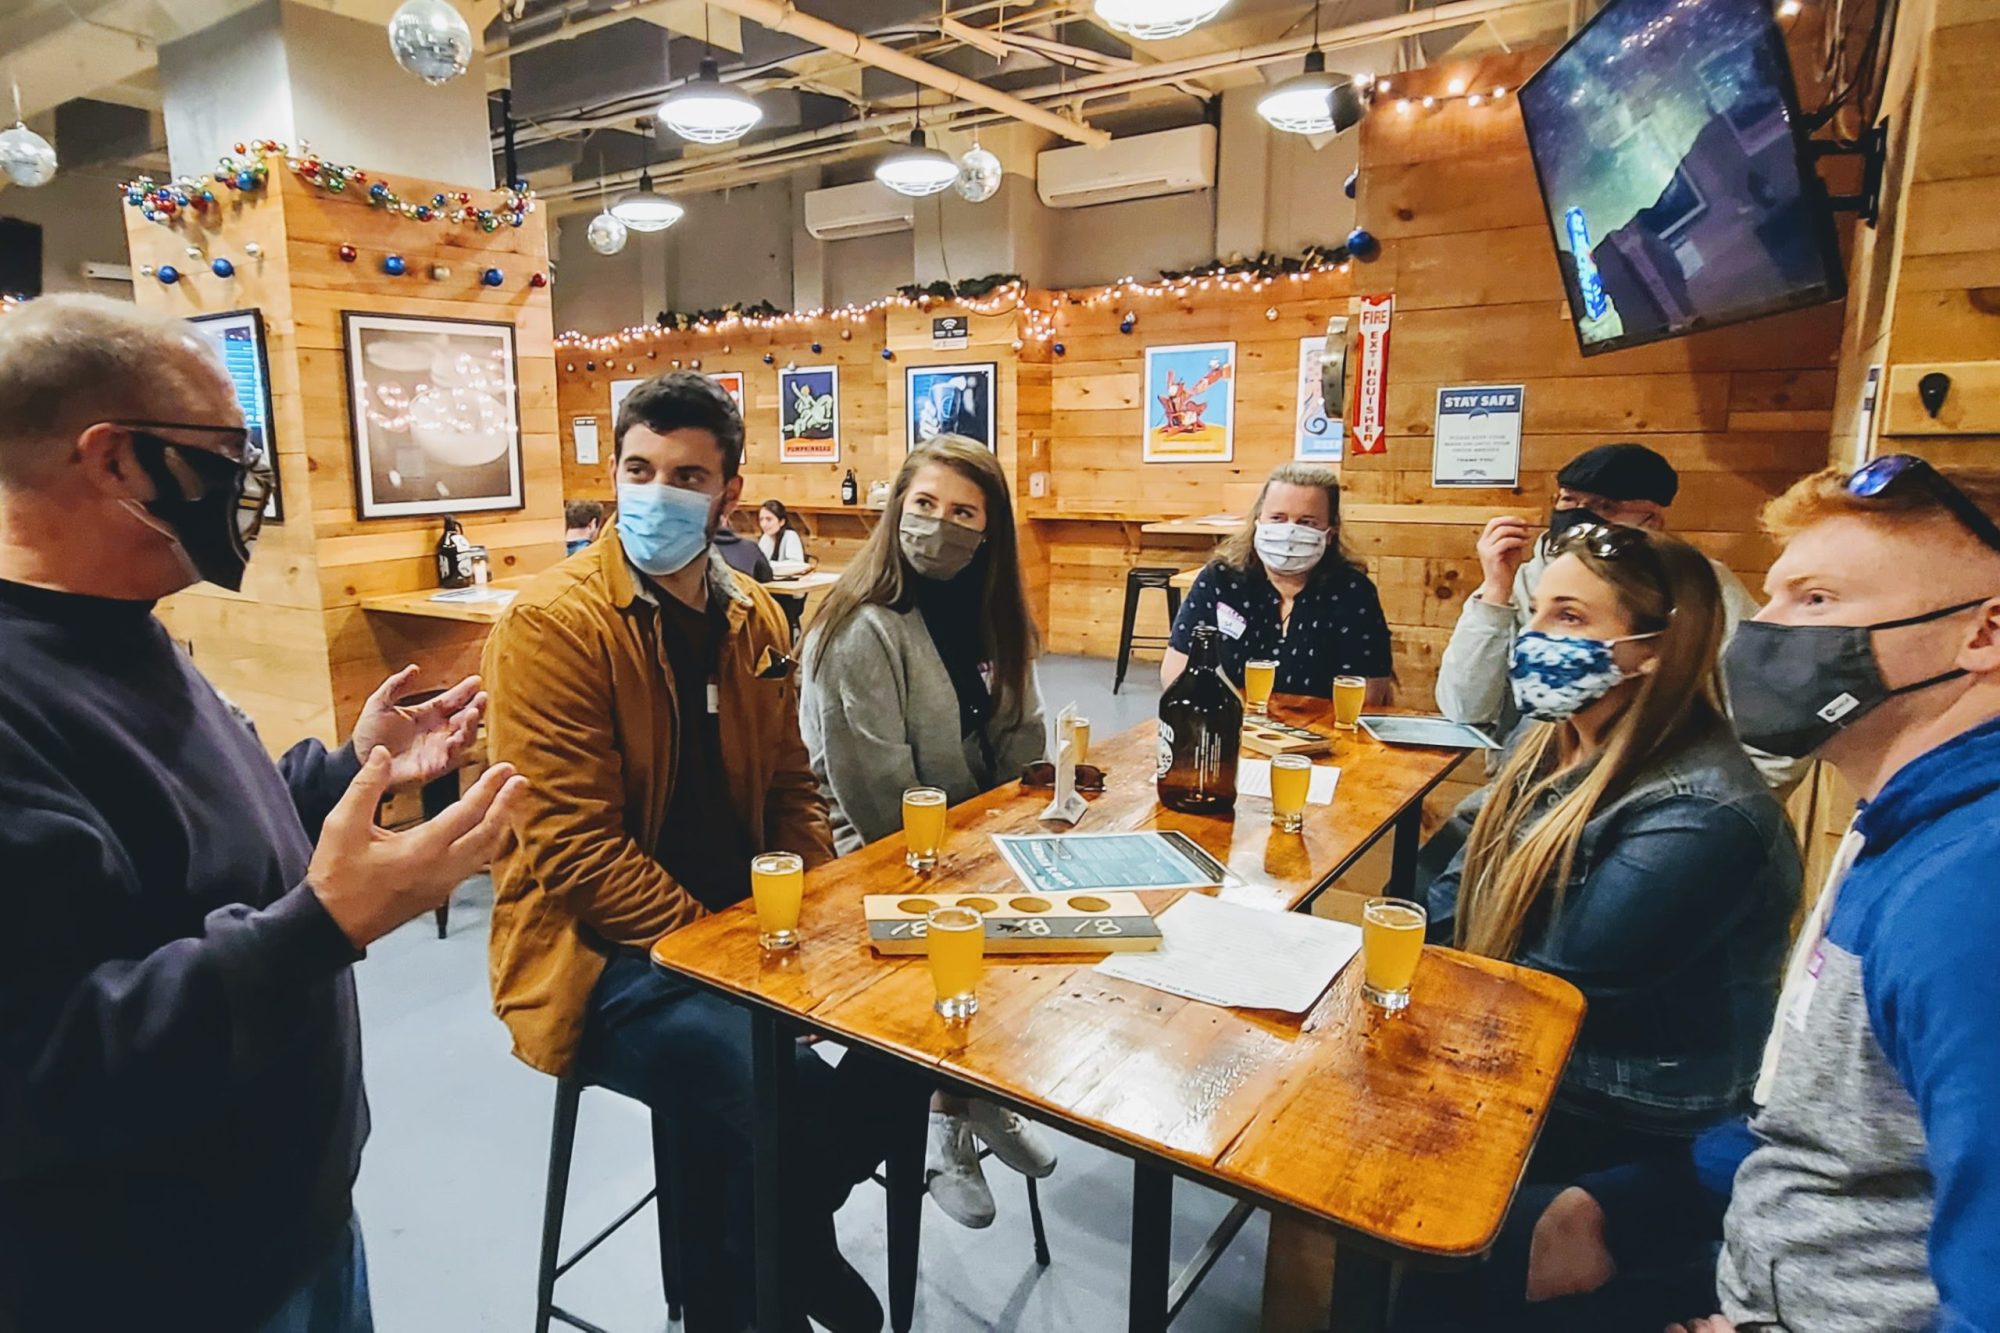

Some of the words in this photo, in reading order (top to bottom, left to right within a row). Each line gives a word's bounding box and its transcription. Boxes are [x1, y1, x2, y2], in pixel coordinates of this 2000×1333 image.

[1362, 310, 1387, 325] FIRE
[1363, 331, 1379, 442] EXTINGUISHER
[1444, 396, 1479, 408] STAY
[1480, 394, 1516, 407] SAFE
